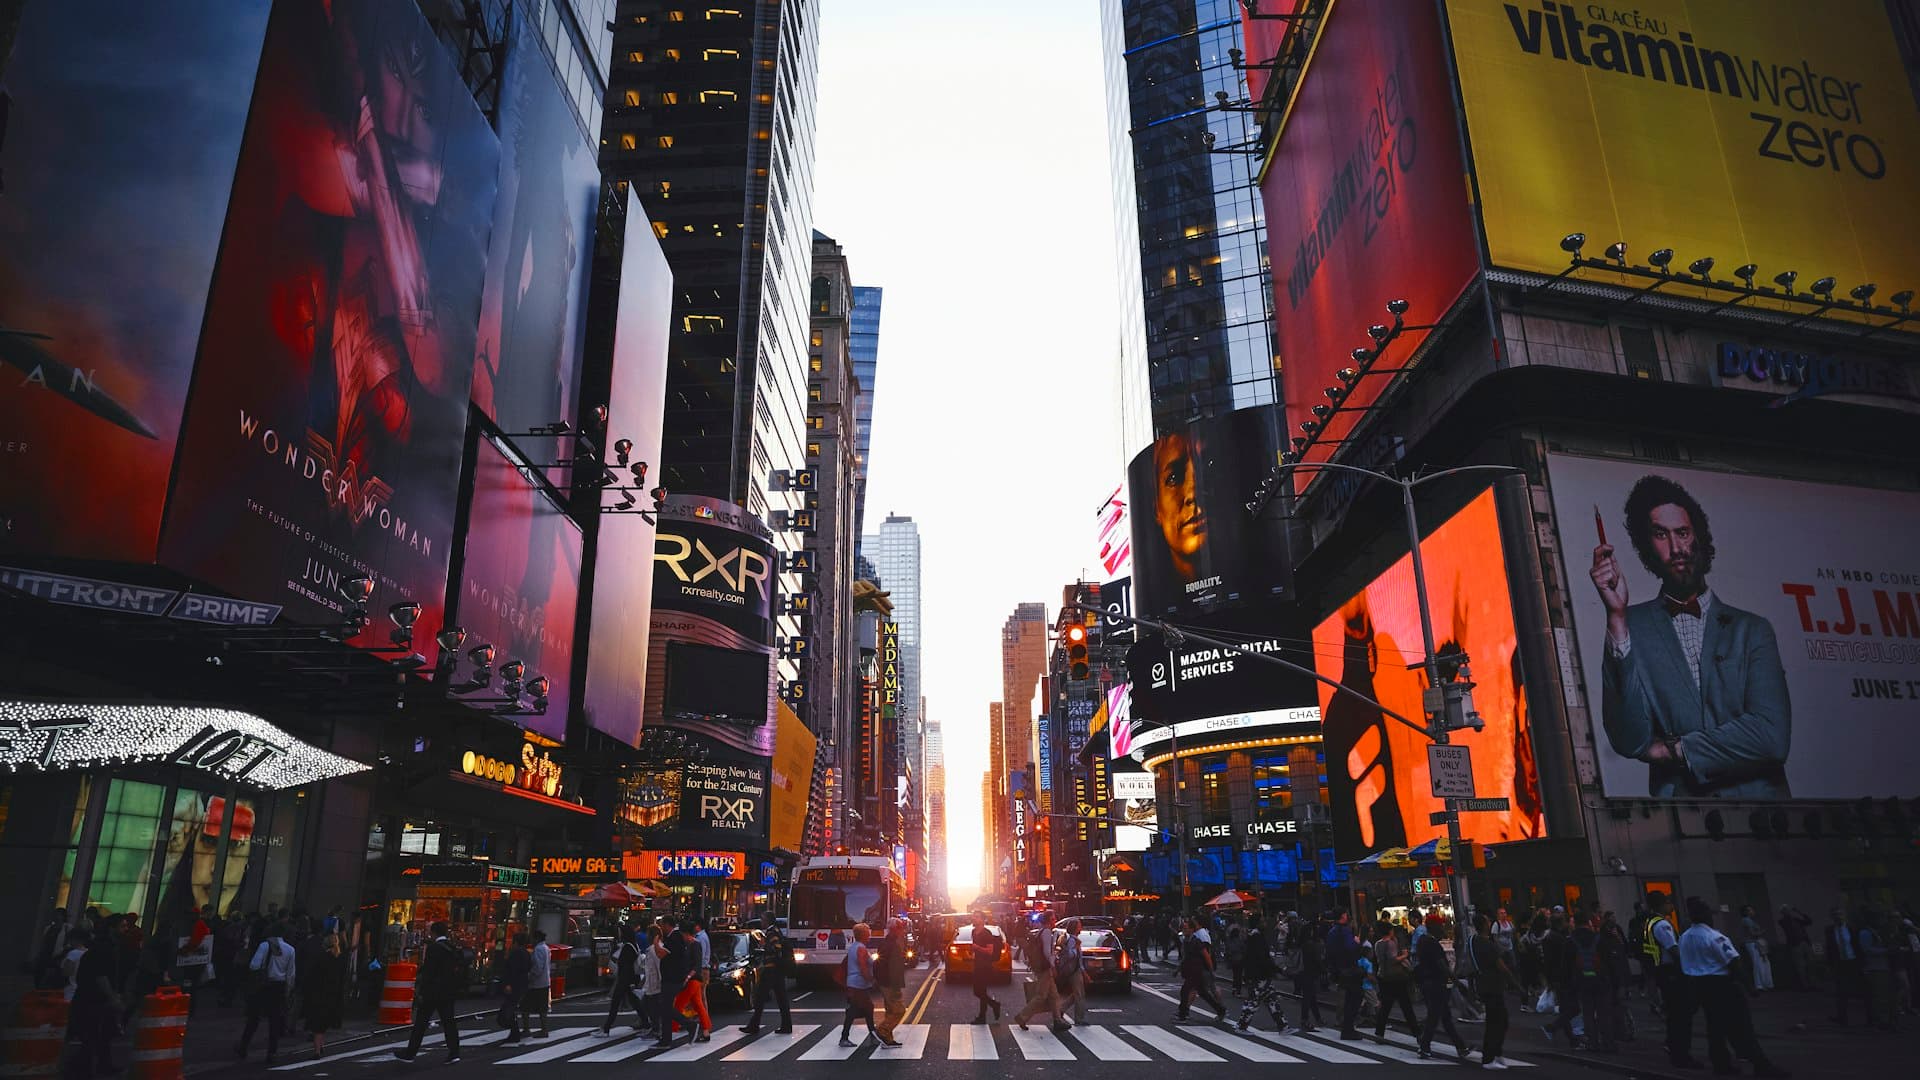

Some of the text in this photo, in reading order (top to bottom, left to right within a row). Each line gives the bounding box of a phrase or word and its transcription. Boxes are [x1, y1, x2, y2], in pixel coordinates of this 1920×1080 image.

[1587, 5, 1668, 36] GLACÉAU
[1505, 1, 1862, 125] vitaminwater
[1750, 112, 1886, 181] zero
[1362, 115, 1417, 247] zero
[239, 408, 432, 558] WONDER WOMAN
[247, 498, 264, 515] THE
[268, 511, 300, 536] FUTURE
[304, 531, 316, 544] OF
[319, 540, 350, 564] JUSTICE
[352, 559, 378, 579] BEGINS
[302, 556, 340, 593] JUN
[654, 532, 769, 603] RXR
[1817, 567, 1835, 579] AN
[1841, 569, 1873, 582] HBO
[681, 584, 745, 605] rxrrealty.com
[1185, 575, 1223, 593] EQUALITY.
[185, 598, 269, 624] PRIME
[470, 578, 569, 657] WONDER WOMAN
[1782, 583, 1872, 636] T.J.
[884, 622, 897, 703] MADAME
[1180, 650, 1219, 666] MAZDA
[1180, 661, 1234, 681] SERVICES
[1851, 677, 1903, 699] JUNE
[1206, 717, 1240, 729] CHASE
[175, 723, 288, 781] LOFT
[1436, 750, 1462, 759] BUSES
[728, 765, 746, 779] New
[747, 767, 762, 781] York
[1440, 761, 1460, 770] ONLY
[686, 777, 764, 798] for the 21st Century
[1095, 756, 1107, 801] VICTORY
[700, 795, 755, 822] RXR
[1468, 799, 1508, 811] Broadway
[711, 820, 747, 829] REALTY
[1014, 800, 1025, 861] REGAL
[1193, 824, 1231, 839] CHASE
[1248, 820, 1297, 835] CHASE
[543, 857, 582, 873] KNOW
[585, 857, 621, 873] GAE
[658, 855, 736, 875] CHAMPS
[1415, 879, 1440, 893] SODA
